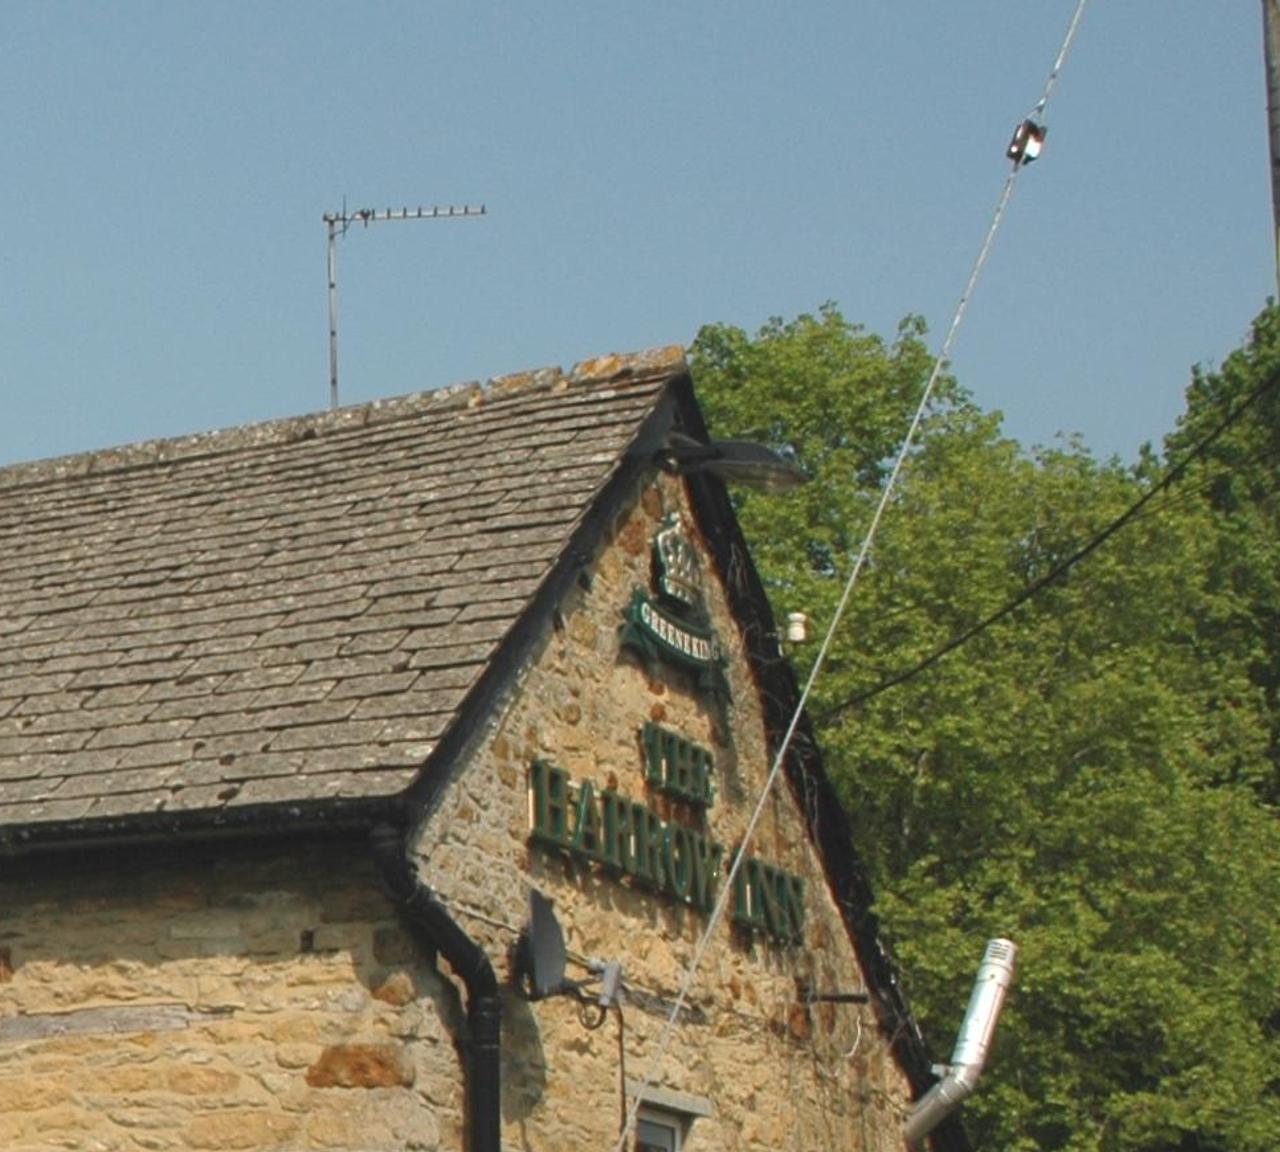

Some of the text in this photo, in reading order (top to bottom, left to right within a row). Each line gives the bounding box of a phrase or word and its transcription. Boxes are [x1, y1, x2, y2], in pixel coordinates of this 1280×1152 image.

[641, 602, 691, 656] GREENE
[642, 721, 714, 808] THE
[528, 759, 724, 914] HARROW
[734, 848, 805, 945] INN
